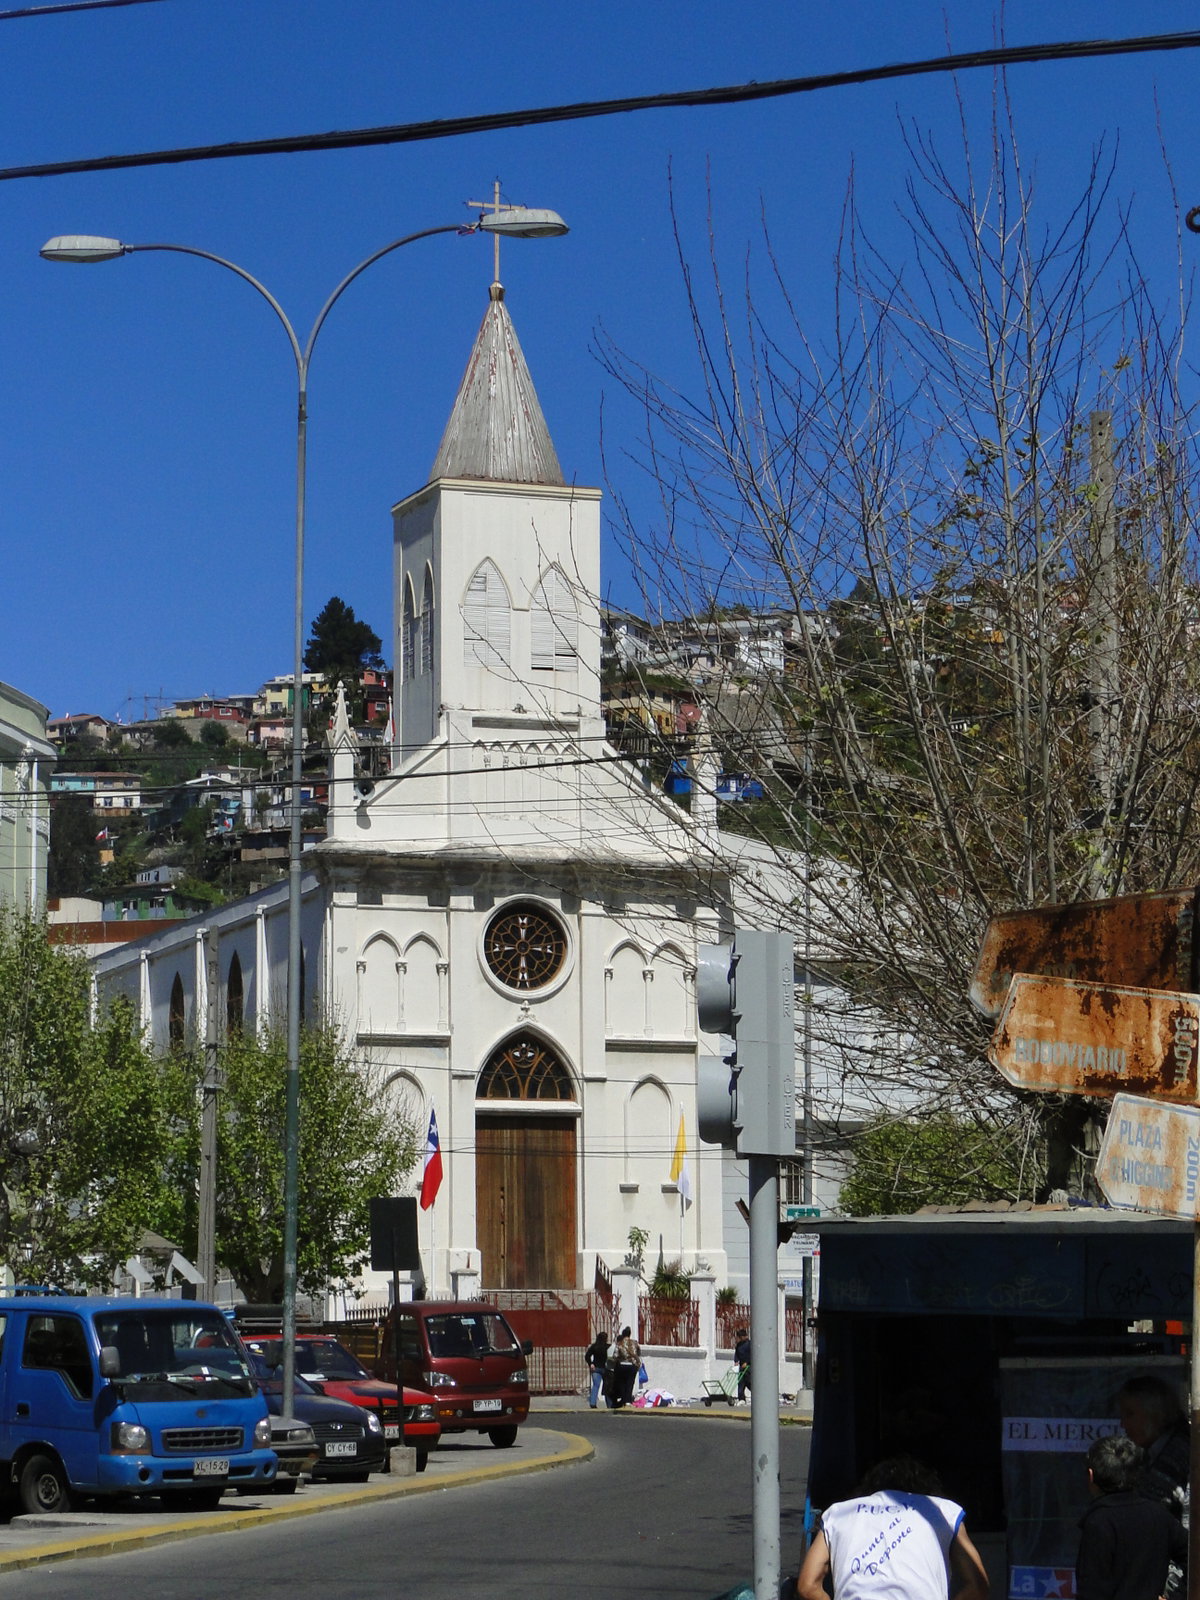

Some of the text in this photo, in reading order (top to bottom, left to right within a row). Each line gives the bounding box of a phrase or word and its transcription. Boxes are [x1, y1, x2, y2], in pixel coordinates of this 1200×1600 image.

[1015, 1036, 1127, 1073] RODOVIARIO
[1119, 1119, 1162, 1151] PLAZA
[1186, 1136, 1200, 1202] 200m
[1007, 1422, 1037, 1440] EL
[889, 1517, 902, 1530] al
[863, 1526, 912, 1577] Deporte
[1009, 1568, 1035, 1593] La
